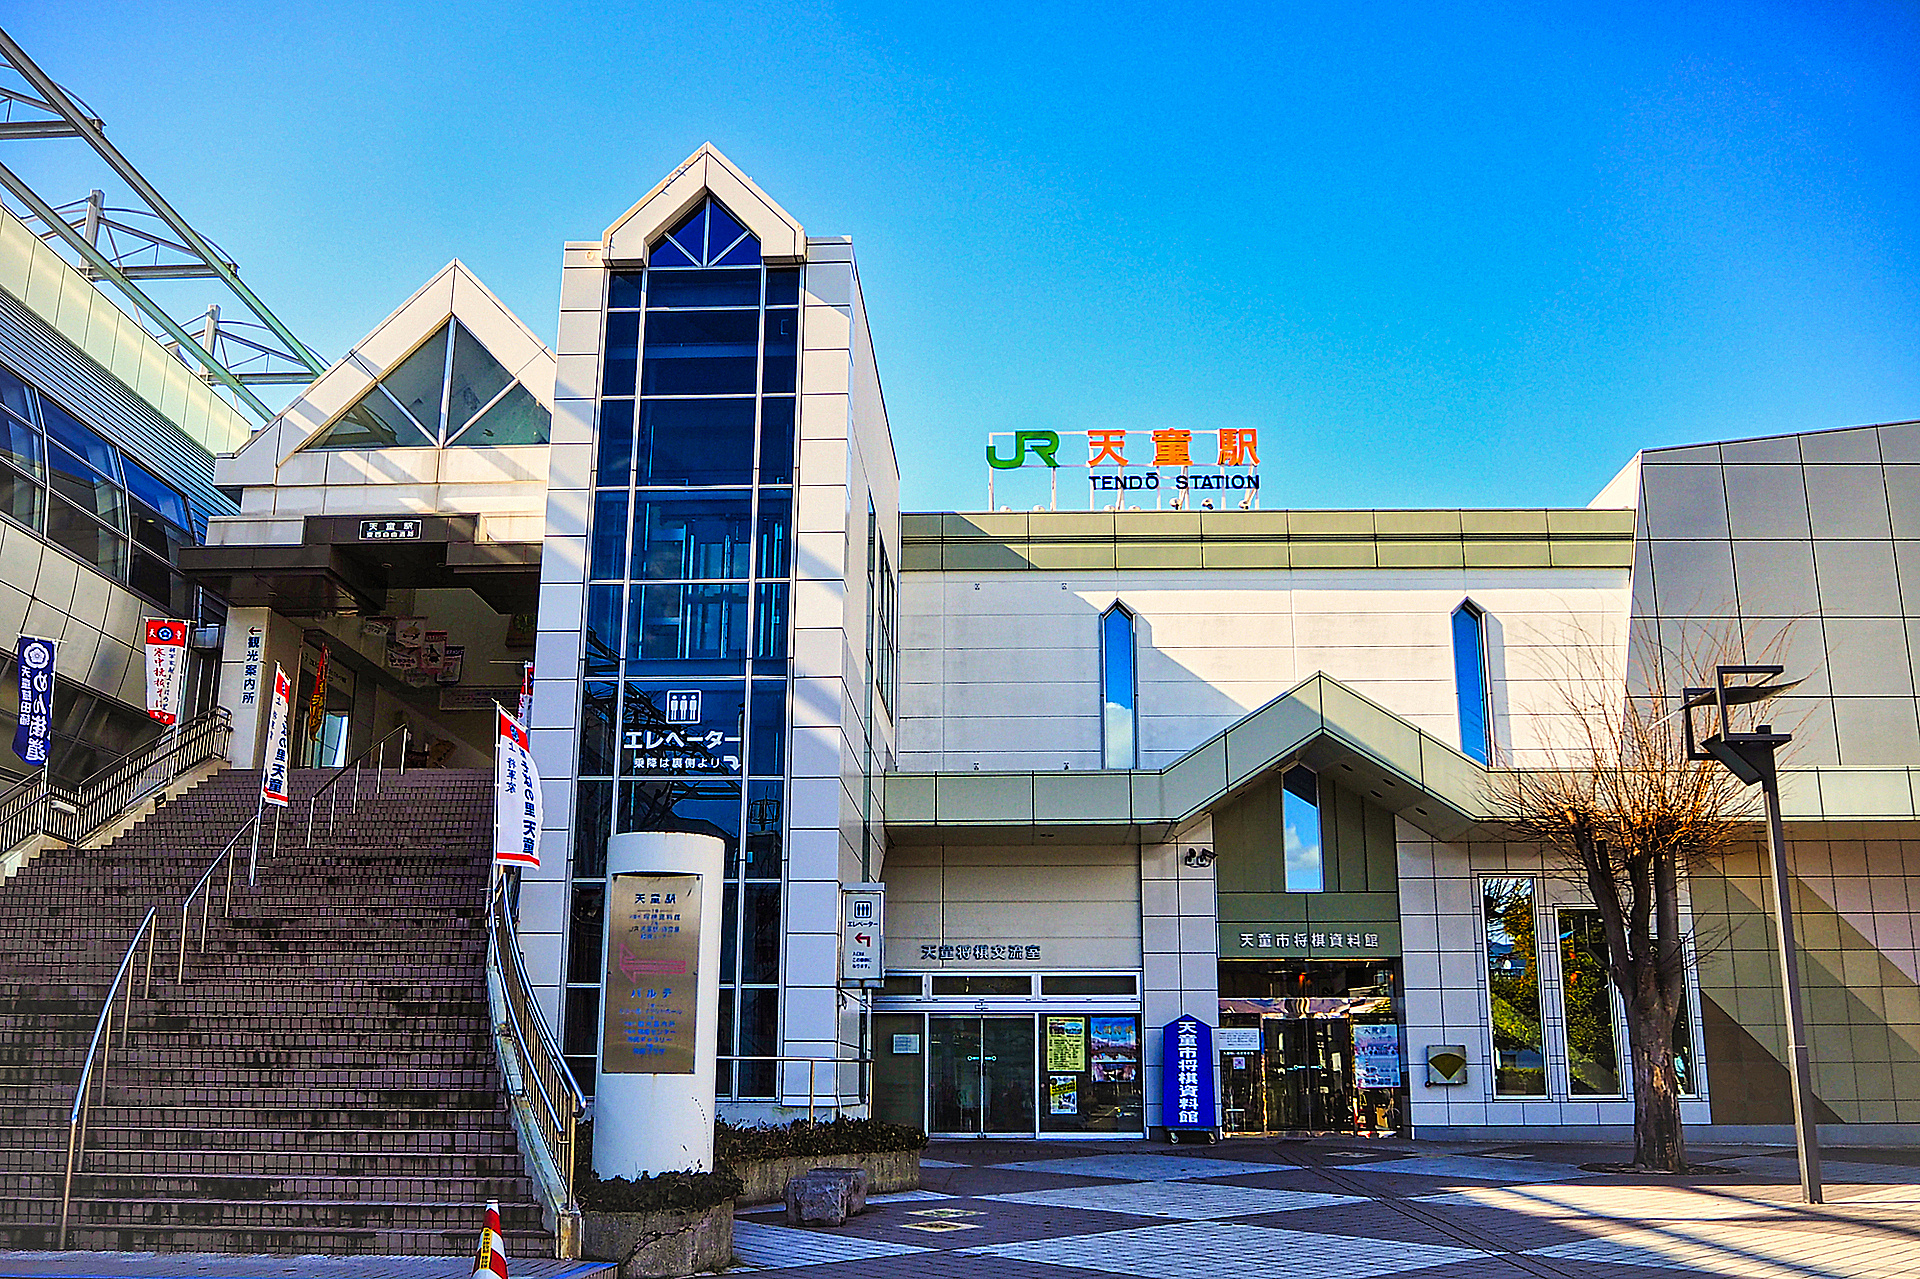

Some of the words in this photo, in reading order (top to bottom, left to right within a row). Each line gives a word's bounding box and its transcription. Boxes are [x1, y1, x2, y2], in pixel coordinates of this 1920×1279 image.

[986, 430, 1060, 469] JR
[1087, 428, 1260, 466] 天童駅
[1088, 472, 1160, 491] TENDŌ
[1175, 474, 1260, 490] STATION
[368, 522, 414, 531] 天童駅
[242, 636, 260, 704] 観光案内所
[624, 730, 741, 750] エレベーター
[634, 757, 720, 769] 乗降は裏側より
[634, 893, 677, 904] 天童駅
[1240, 932, 1379, 948] 天童市将棋資料館
[920, 944, 1041, 960] 天童将棋交流室
[1177, 1021, 1199, 1124] 天童市将棋資料館
